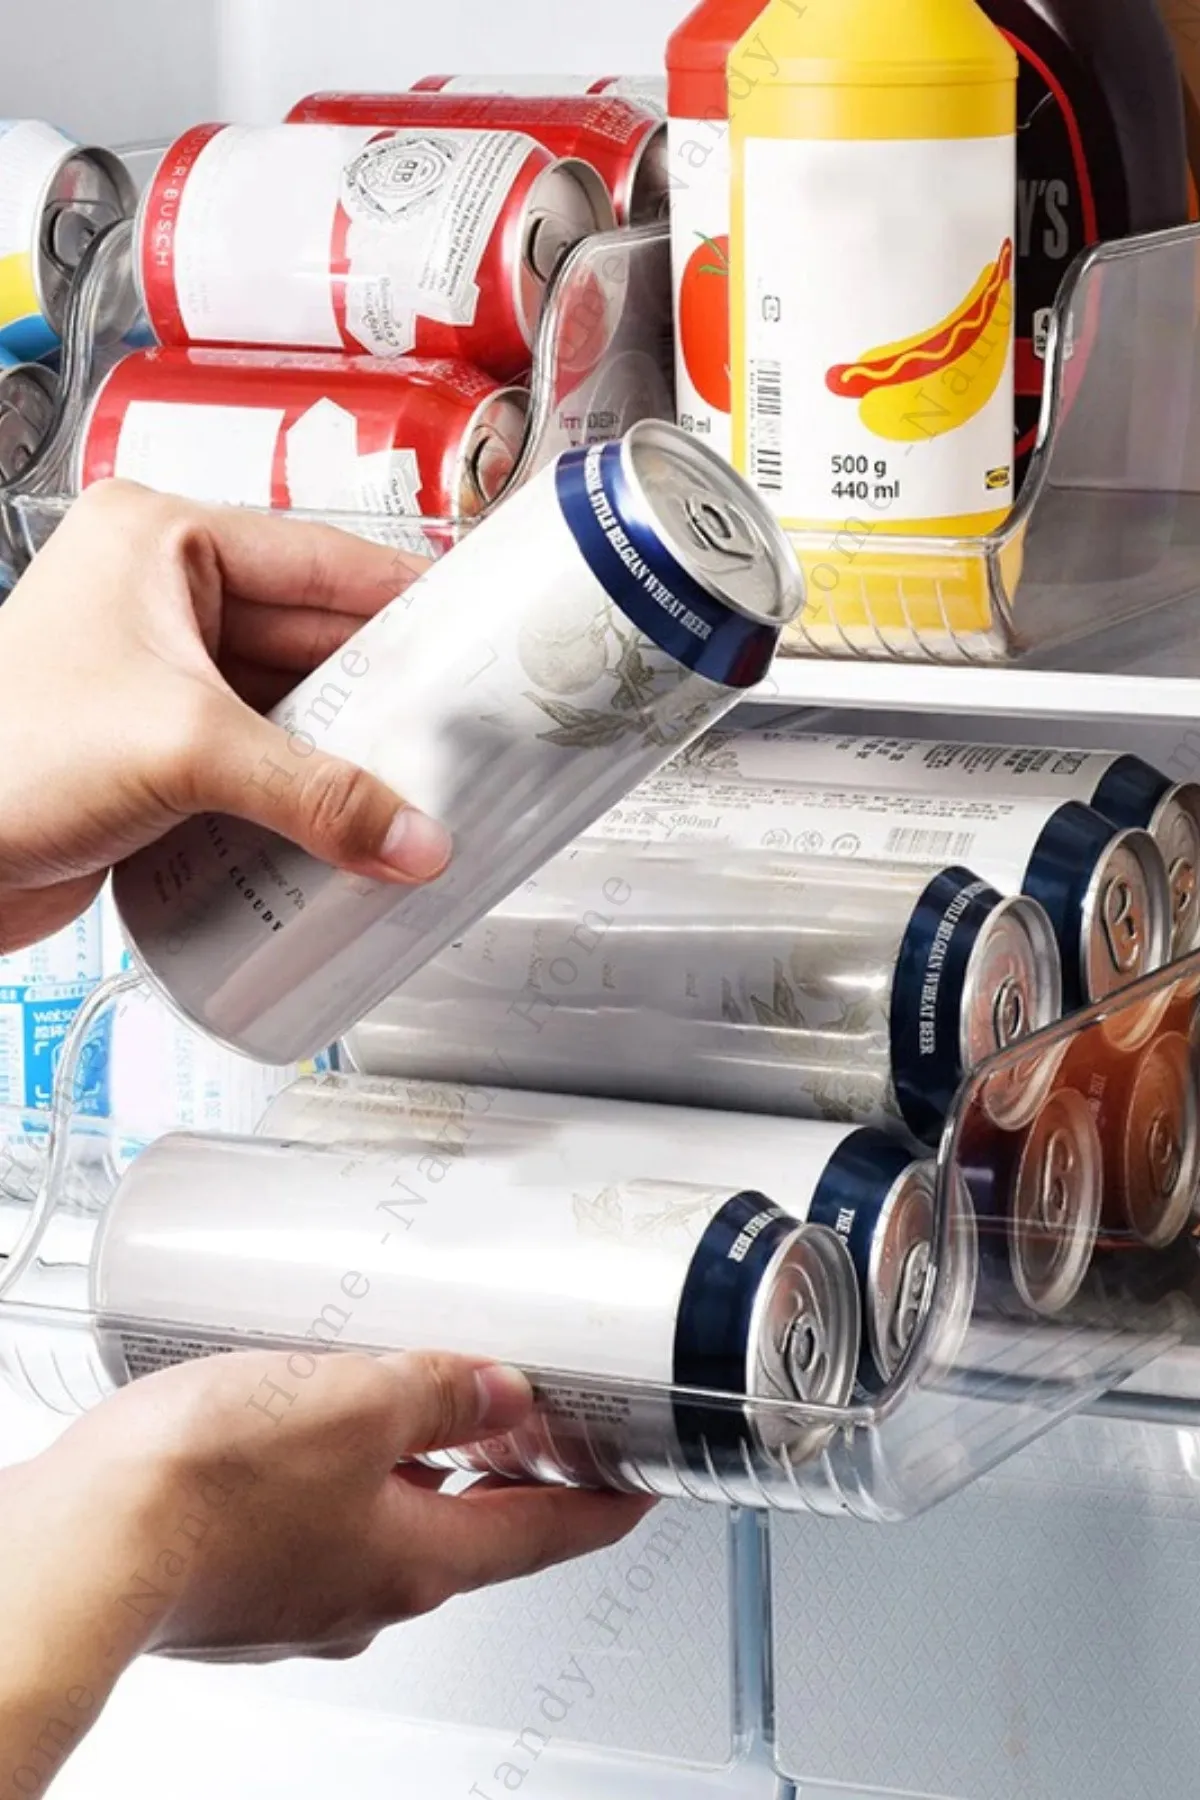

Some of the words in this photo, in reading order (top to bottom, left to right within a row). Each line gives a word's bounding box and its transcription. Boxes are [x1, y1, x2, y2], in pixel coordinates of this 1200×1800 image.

[1018, 179, 1070, 260] Y'S
[830, 454, 869, 475] 500
[874, 459, 888, 478] g
[831, 481, 869, 499] 440
[874, 480, 900, 499] ml
[607, 525, 651, 581] BELGIAN
[642, 573, 686, 618] WHEAT
[679, 608, 715, 640] BEER
